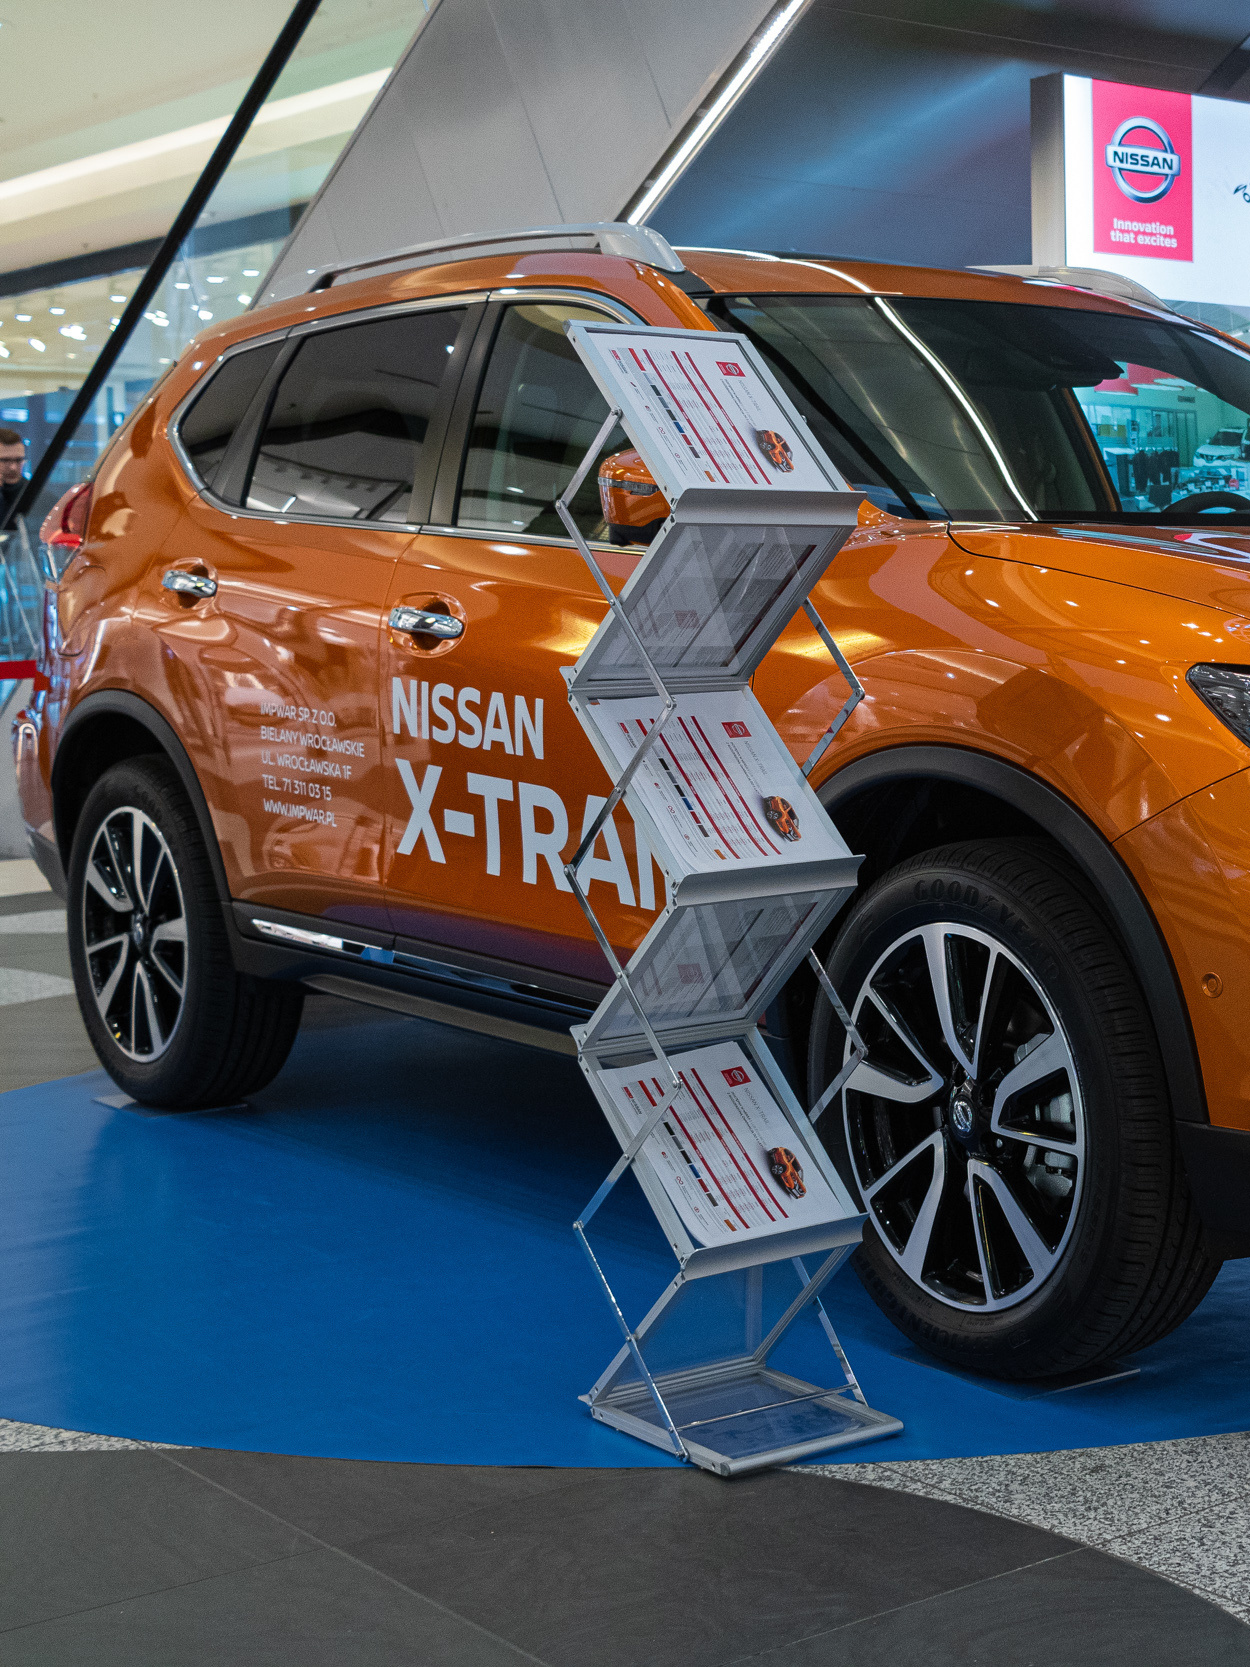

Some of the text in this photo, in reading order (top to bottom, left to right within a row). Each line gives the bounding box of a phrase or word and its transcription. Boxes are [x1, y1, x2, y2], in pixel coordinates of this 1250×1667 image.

[1113, 151, 1173, 171] NISSAN
[1110, 230, 1178, 248] that excites
[1113, 218, 1174, 235] Innovation
[260, 702, 297, 720] IMPWAR
[311, 709, 318, 724] Z
[392, 676, 544, 760] NISSAN
[260, 725, 365, 758] BIELANY WROCŁAWSKIE
[276, 753, 342, 778] WROCŁAWSKA
[342, 765, 352, 779] 1F
[282, 777, 292, 793] 71
[294, 780, 307, 795] 311
[308, 783, 320, 799] 03
[322, 786, 332, 801] 15
[263, 798, 338, 828] WWW.IMPWAR.PL
[395, 757, 672, 912] X-TRAI
